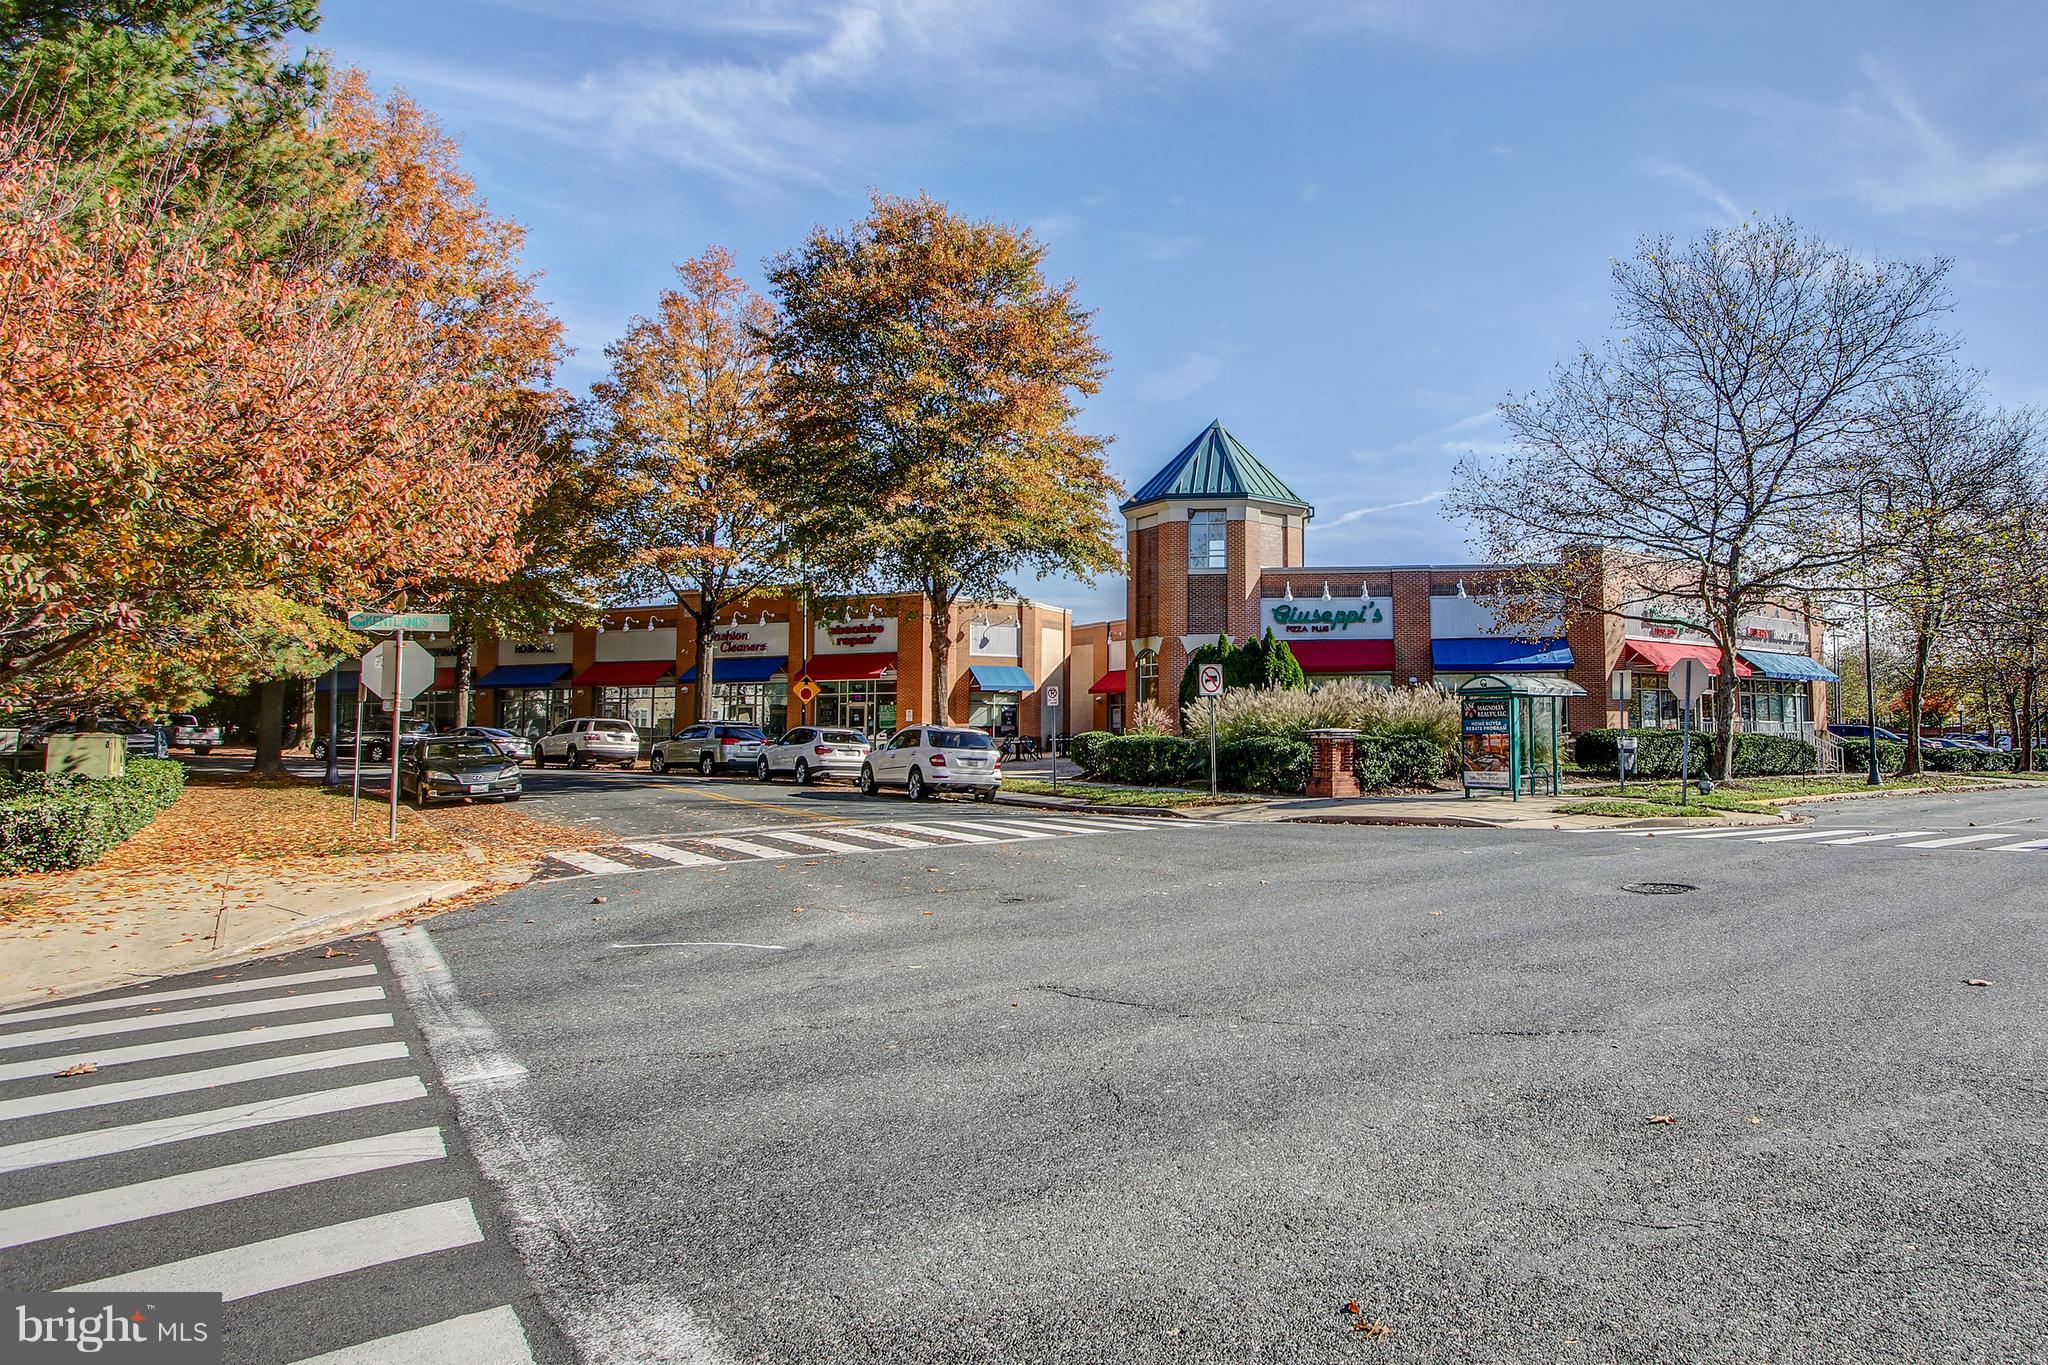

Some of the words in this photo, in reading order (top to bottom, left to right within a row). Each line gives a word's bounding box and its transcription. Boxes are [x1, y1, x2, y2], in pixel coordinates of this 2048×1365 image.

[365, 616, 429, 627] KENTLANDS
[1272, 601, 1383, 631] Giuseppi's
[714, 630, 749, 641] ashion
[837, 635, 877, 647] repair
[720, 642, 768, 652] Cleaners
